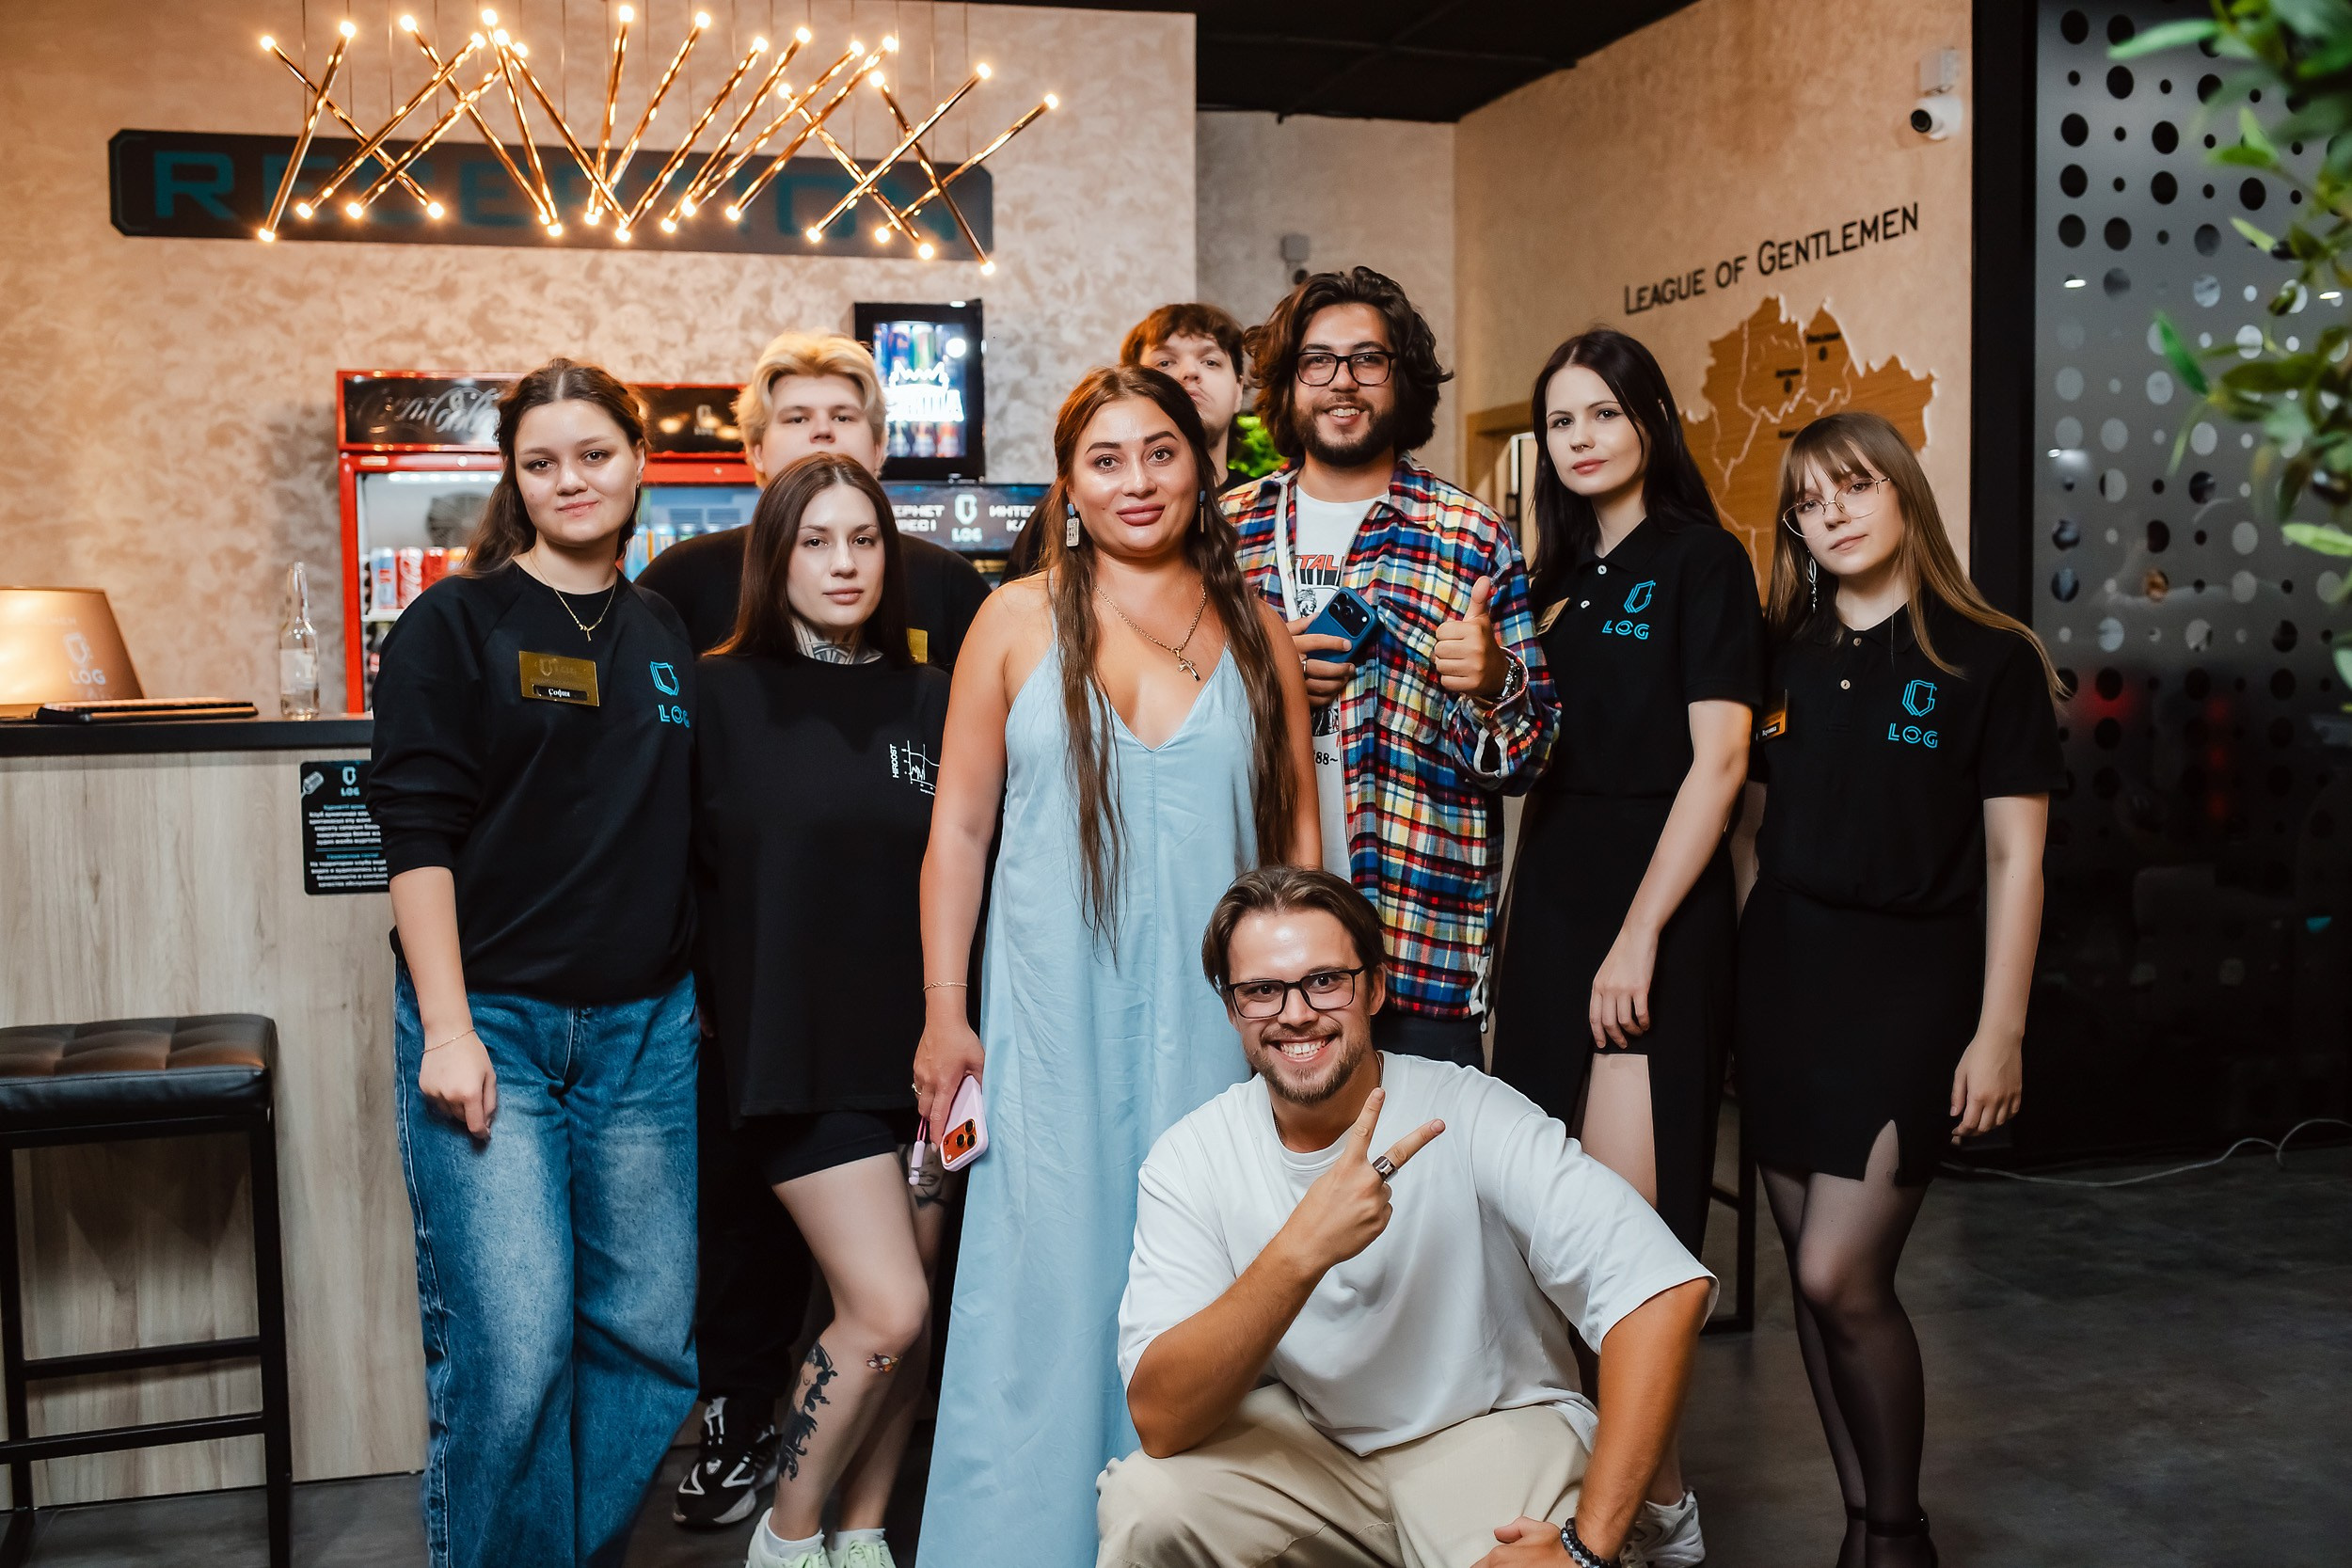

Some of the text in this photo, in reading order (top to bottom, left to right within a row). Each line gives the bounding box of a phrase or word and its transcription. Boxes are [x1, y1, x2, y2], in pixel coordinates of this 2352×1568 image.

[152, 150, 959, 242] REEPON
[1624, 201, 1918, 315] LEAGUE OF GENTLEMEN
[1295, 554, 1343, 578] TAL
[1601, 620, 1650, 640] LOG
[68, 668, 106, 686] LOG
[548, 688, 571, 699] София
[1887, 722, 1938, 749] LOG
[341, 786, 360, 797] LOG
